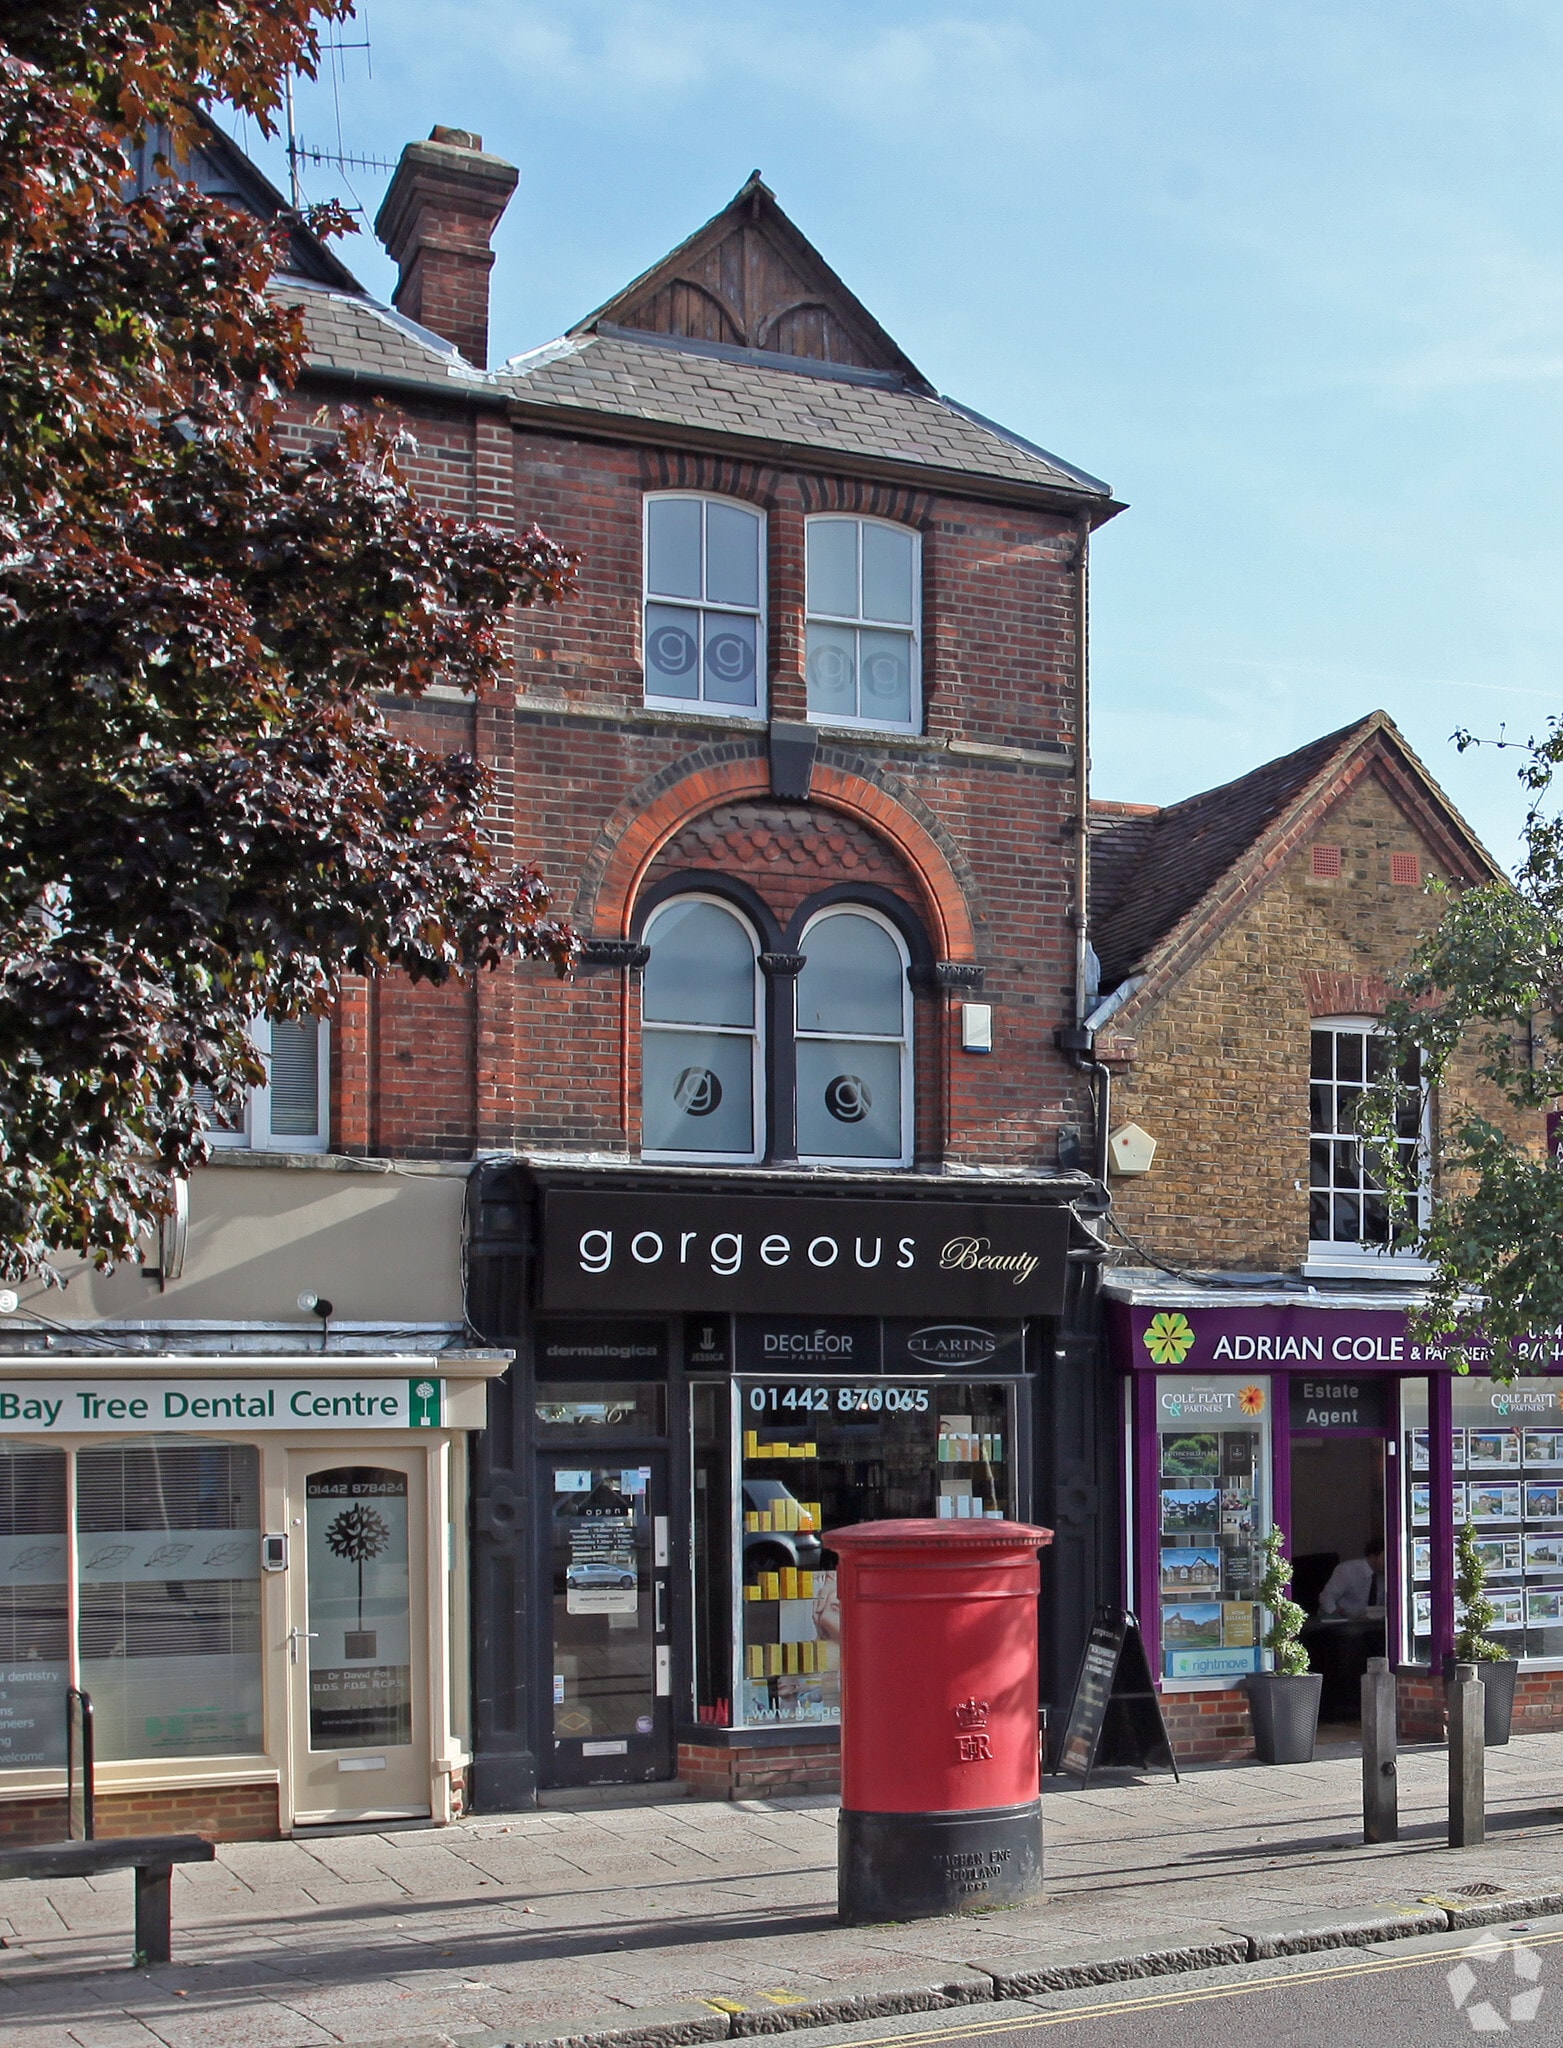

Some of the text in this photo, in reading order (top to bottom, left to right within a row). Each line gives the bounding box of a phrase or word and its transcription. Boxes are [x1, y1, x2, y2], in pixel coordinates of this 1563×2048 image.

[578, 1229, 1040, 1285] gorgeous Beauty
[546, 1345, 657, 1358] dermalogica
[907, 1338, 996, 1352] CLARINS
[1212, 1335, 1496, 1361] ADRIAN COLE & PARNER
[691, 1352, 724, 1362] JESSICA
[1303, 1383, 1359, 1398] Estate
[750, 1387, 929, 1411] 01442 870065
[1161, 1393, 1236, 1409] COLE FLATT
[1490, 1393, 1556, 1408] COLE FLATT
[0, 1389, 399, 1427] Bay Tree Dental Centre
[1169, 1402, 1223, 1417] & PARTNERS
[1498, 1401, 1545, 1416] & PARTNERS
[1305, 1408, 1359, 1426] Agent
[308, 1482, 405, 1496] 01442 878424
[586, 1508, 621, 1517] open
[1192, 1656, 1248, 1674] rightmove
[7, 1671, 59, 1682] dentistry
[328, 1673, 339, 1681] Dr
[343, 1671, 371, 1680] David
[945, 1864, 1002, 1881] SCOTLAND
